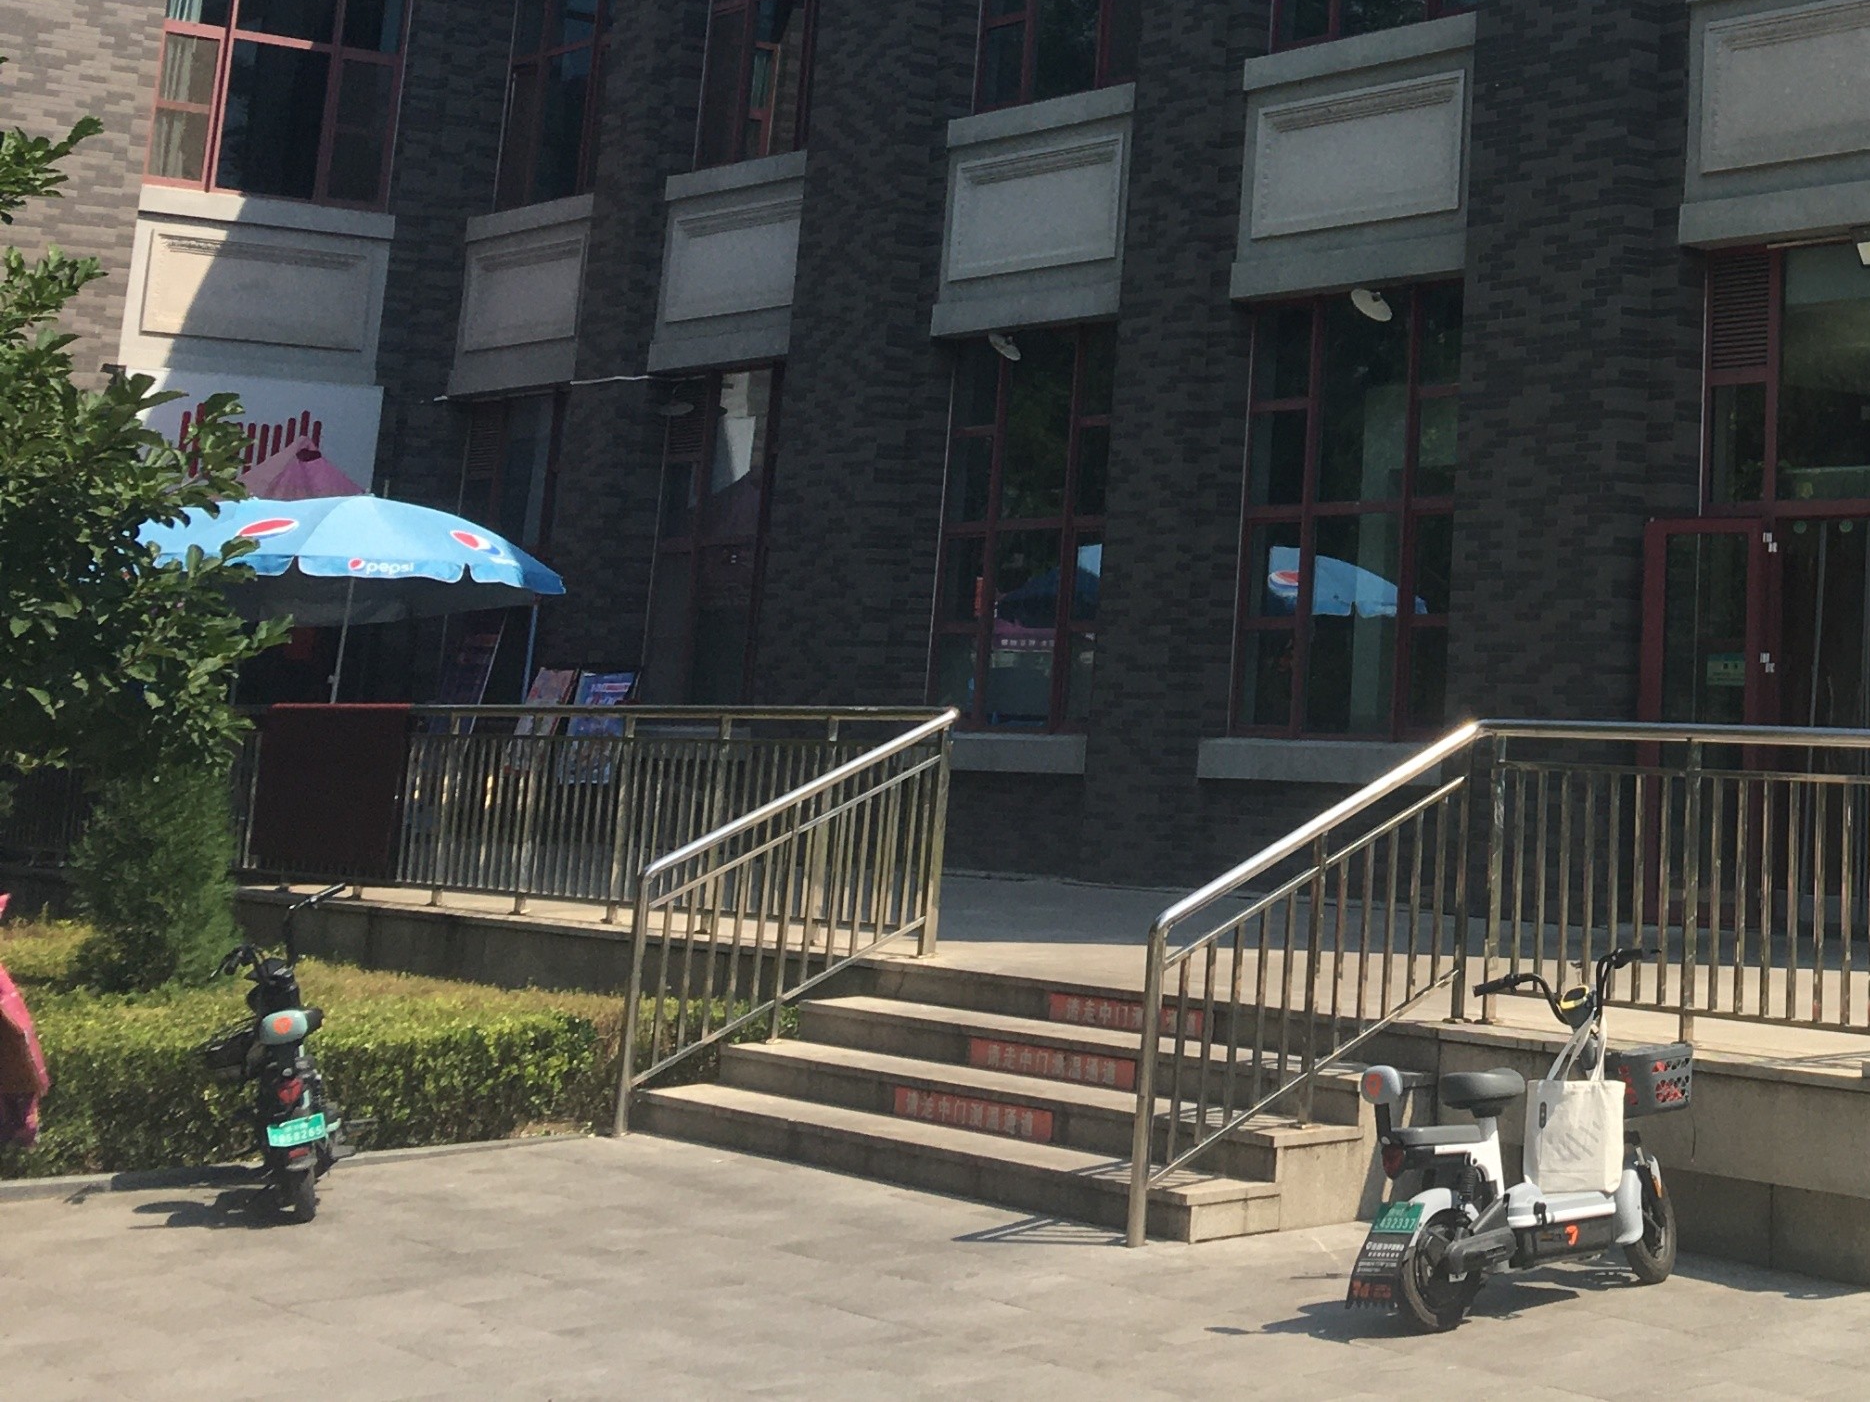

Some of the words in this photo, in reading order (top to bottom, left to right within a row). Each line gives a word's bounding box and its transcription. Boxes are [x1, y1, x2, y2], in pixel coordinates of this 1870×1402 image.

[366, 561, 415, 577] pepsi
[1066, 998, 1197, 1038] 请走中门测通道
